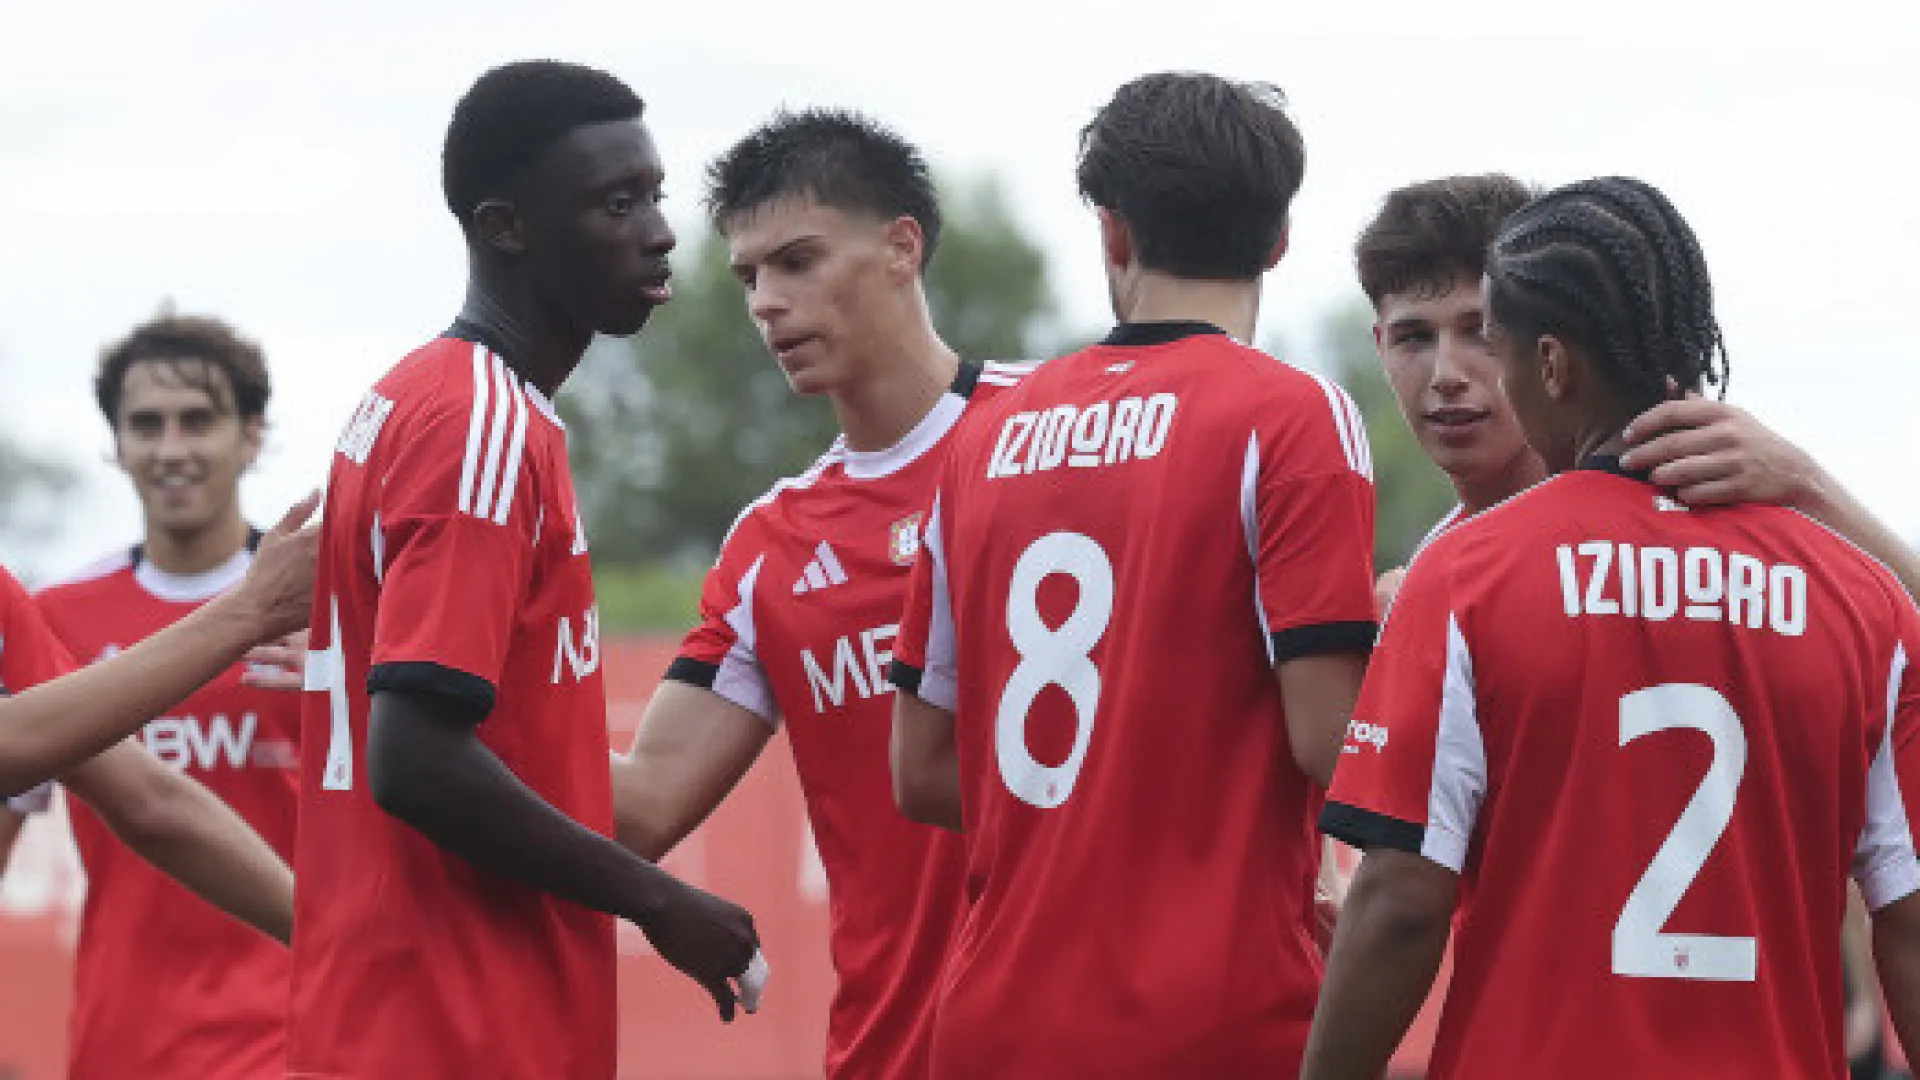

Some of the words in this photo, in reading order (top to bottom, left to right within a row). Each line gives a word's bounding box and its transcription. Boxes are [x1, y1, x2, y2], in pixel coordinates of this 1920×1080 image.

[987, 393, 1178, 481] IZIDORO
[996, 531, 1115, 809] 8
[1556, 540, 1807, 636] IZIDORO
[1611, 683, 1757, 982] 2
